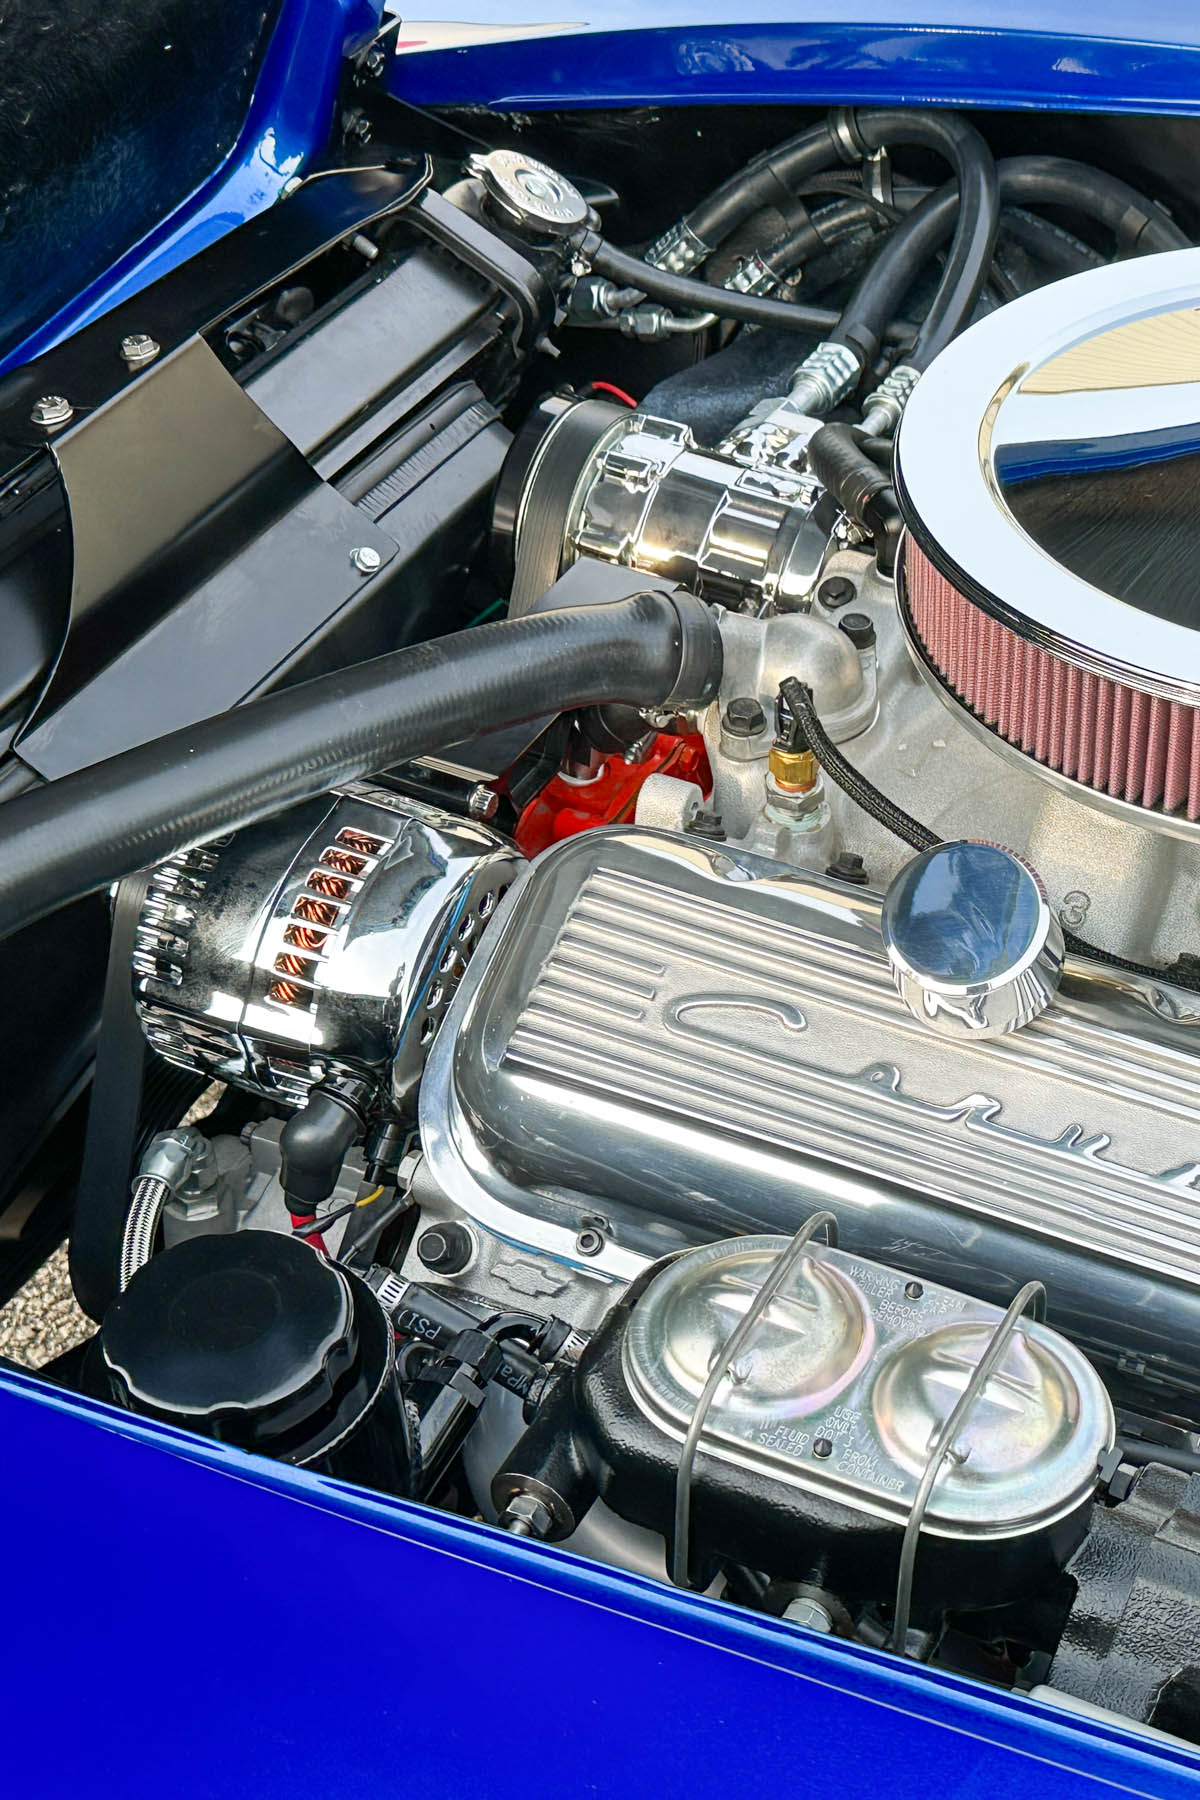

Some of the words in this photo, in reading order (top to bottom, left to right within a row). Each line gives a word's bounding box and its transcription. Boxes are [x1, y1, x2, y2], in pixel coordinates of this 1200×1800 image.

[1058, 890, 1092, 929] 3
[397, 1308, 443, 1341] PSI)
[825, 1416, 858, 1434] ONLY
[834, 1405, 862, 1423] USE
[774, 1425, 810, 1446] FLUID
[841, 1448, 878, 1470] FROM
[814, 1425, 843, 1441] DOT
[758, 1432, 804, 1457] SEALED
[836, 1461, 905, 1493] CONTAINER
